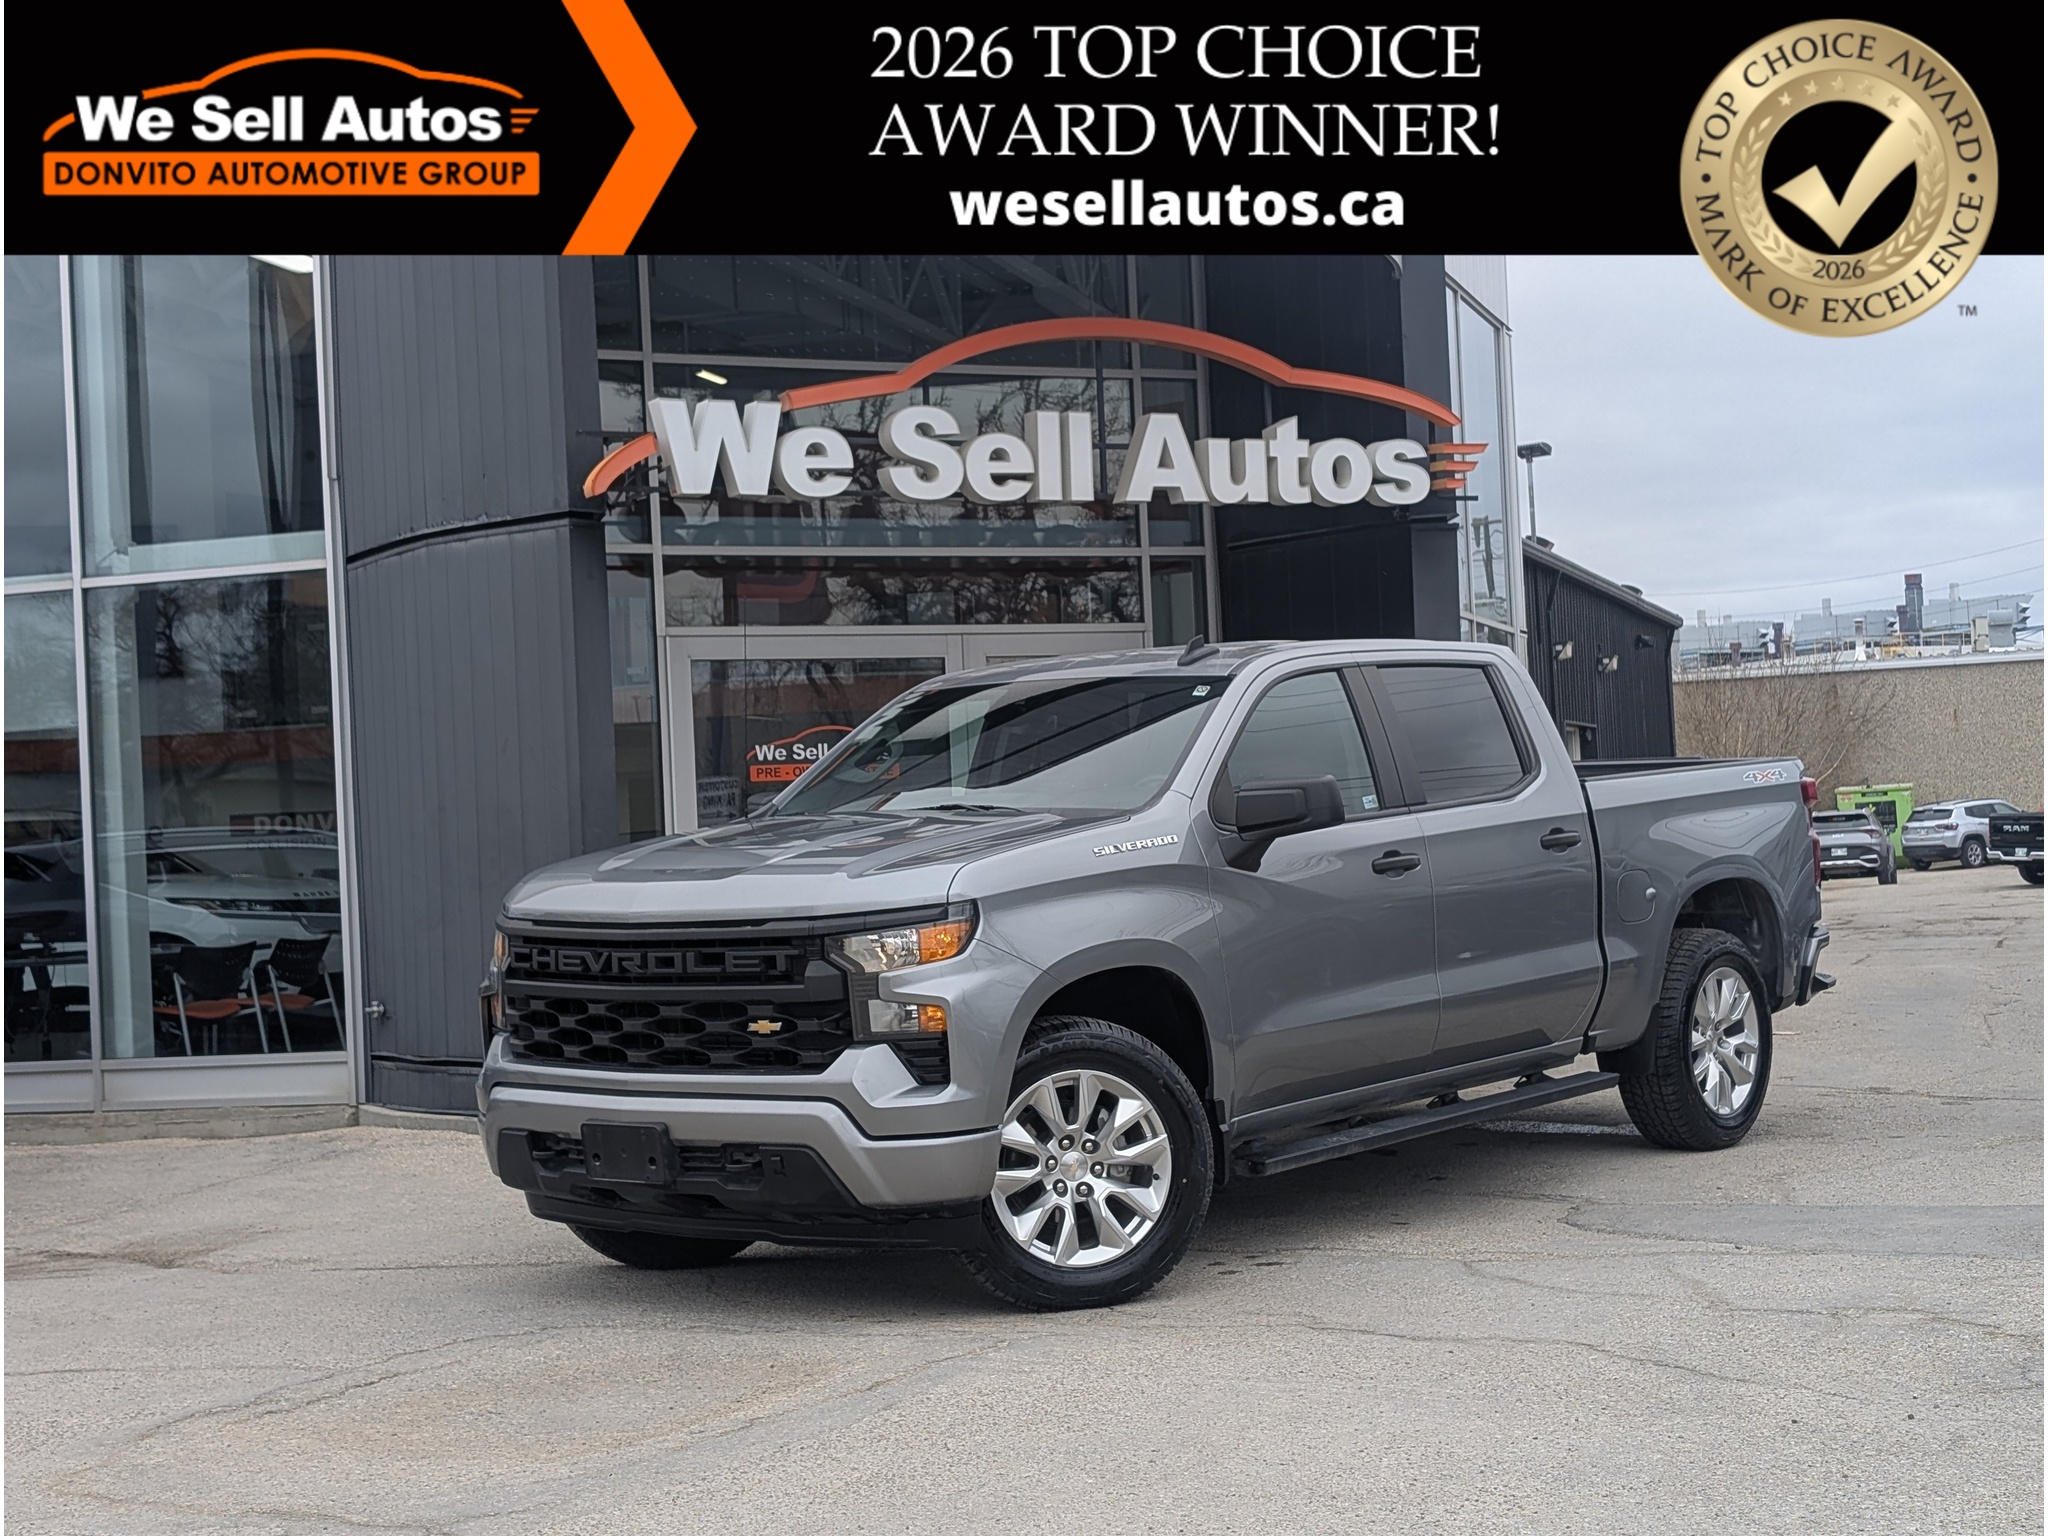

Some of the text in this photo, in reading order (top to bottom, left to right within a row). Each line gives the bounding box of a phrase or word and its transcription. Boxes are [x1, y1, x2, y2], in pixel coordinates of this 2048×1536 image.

[648, 397, 1433, 506] We Sell Autos
[755, 742, 830, 761] We Sell
[756, 767, 782, 779] PRE
[2002, 824, 2030, 833] RAM
[1092, 834, 1179, 857] SILVERADO
[509, 945, 799, 974] CHEVROLET
